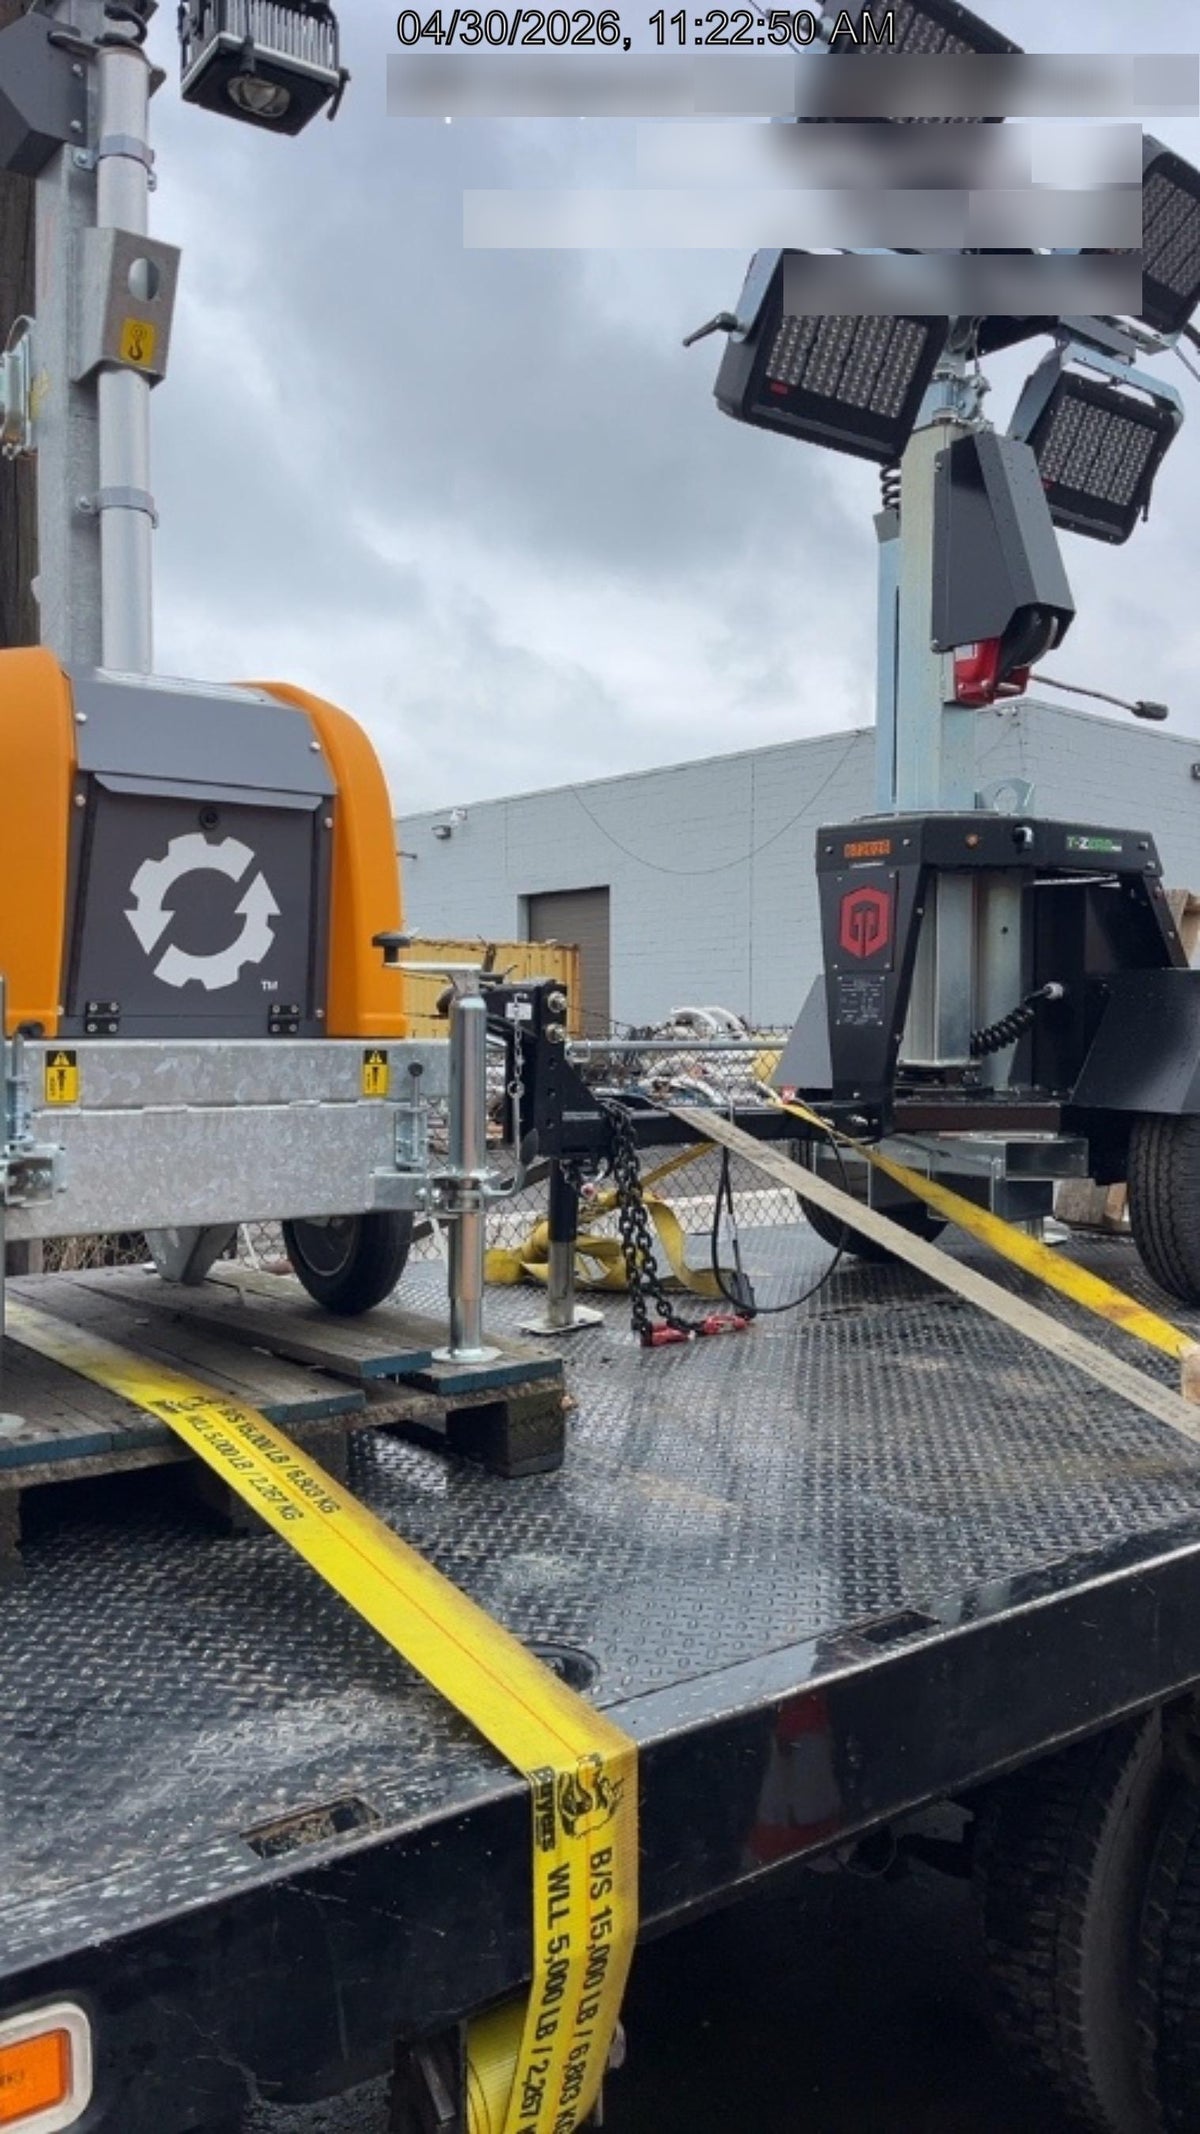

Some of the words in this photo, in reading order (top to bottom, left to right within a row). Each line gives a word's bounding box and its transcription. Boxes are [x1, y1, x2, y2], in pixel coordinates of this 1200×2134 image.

[547, 1862, 570, 1930] WLL
[590, 1847, 613, 1901] B/S
[543, 1934, 571, 2006] 5,000
[584, 1905, 613, 1990] 15,000
[535, 2007, 561, 2041] LB
[576, 1991, 602, 2025] LB
[519, 2060, 549, 2118] 2,267
